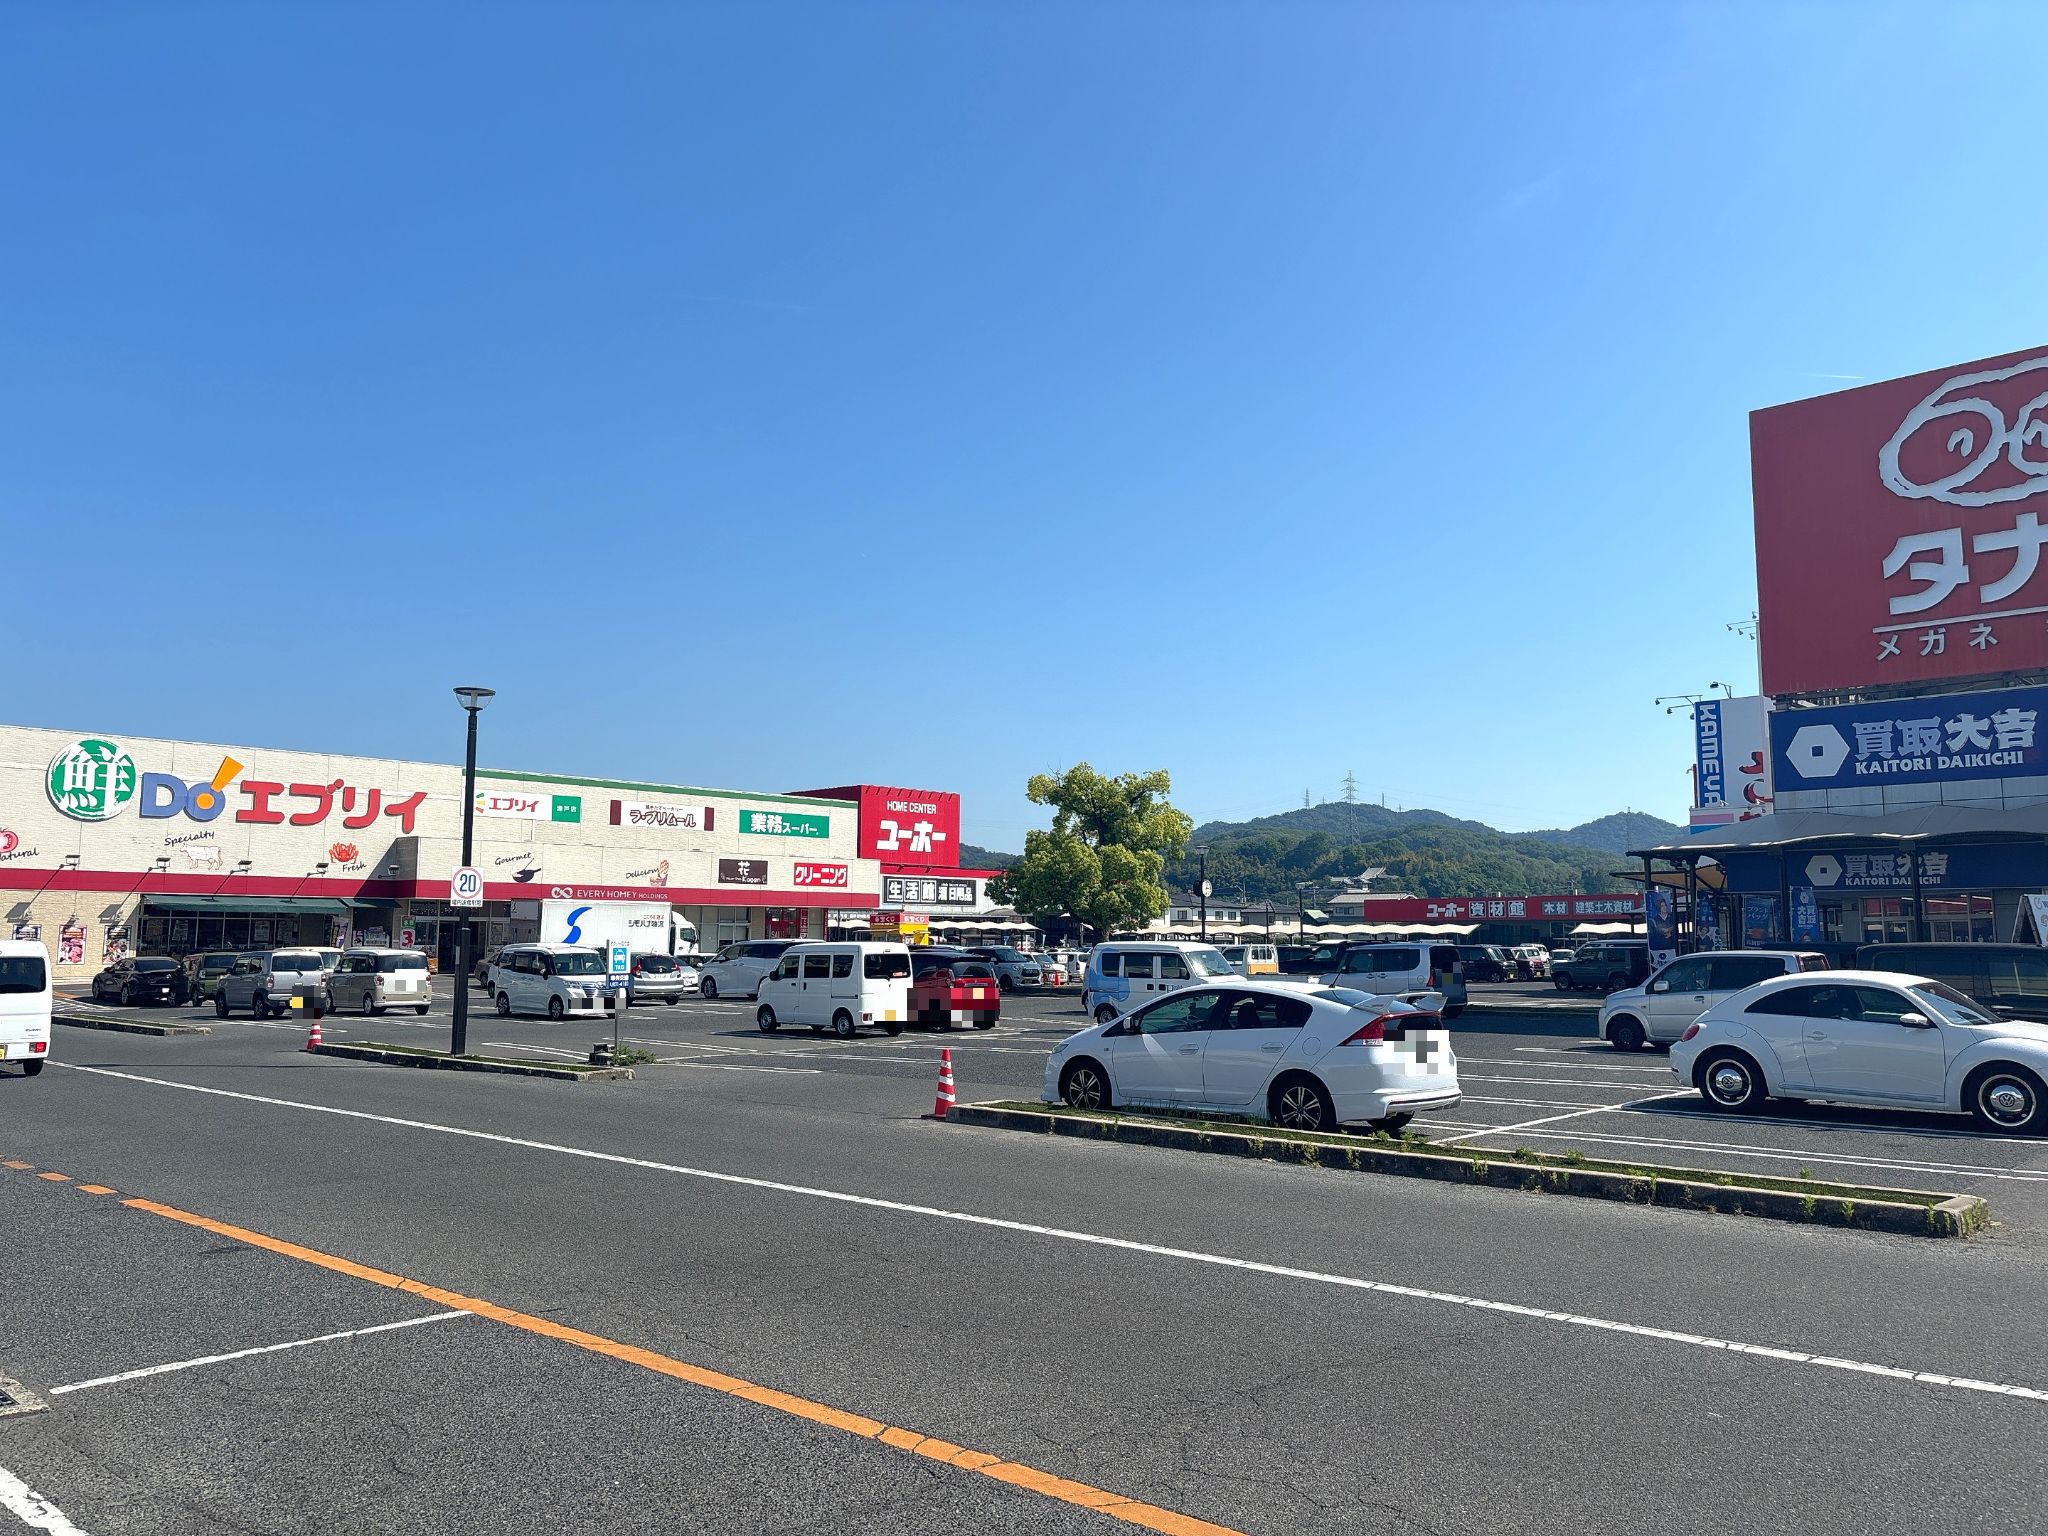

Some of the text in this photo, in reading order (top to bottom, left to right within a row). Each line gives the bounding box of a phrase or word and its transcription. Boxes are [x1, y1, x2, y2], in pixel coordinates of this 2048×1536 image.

[1882, 512, 2048, 615] タナ
[1852, 708, 2038, 761] 買取大吉
[1699, 703, 1722, 807] KAMEYA
[1855, 750, 2024, 775] KAITORI DAIKICHI
[887, 800, 937, 814] HOME CENTER
[750, 812, 819, 835] 業務スーパー
[164, 830, 215, 846] Specialty
[876, 819, 947, 853] ユーホー
[342, 861, 367, 873] Fresh
[494, 852, 532, 866] Gourmet
[1843, 852, 1949, 877] 買取大吉
[737, 861, 750, 876] 花
[794, 866, 848, 885] クリーニング
[459, 873, 477, 892] 20
[1845, 876, 1941, 886] KAITORI DAIICHI
[577, 889, 607, 898] EVERY
[1426, 903, 1465, 918] ユーホー
[1469, 901, 1526, 918] 資材館
[1543, 901, 1568, 915] 木材
